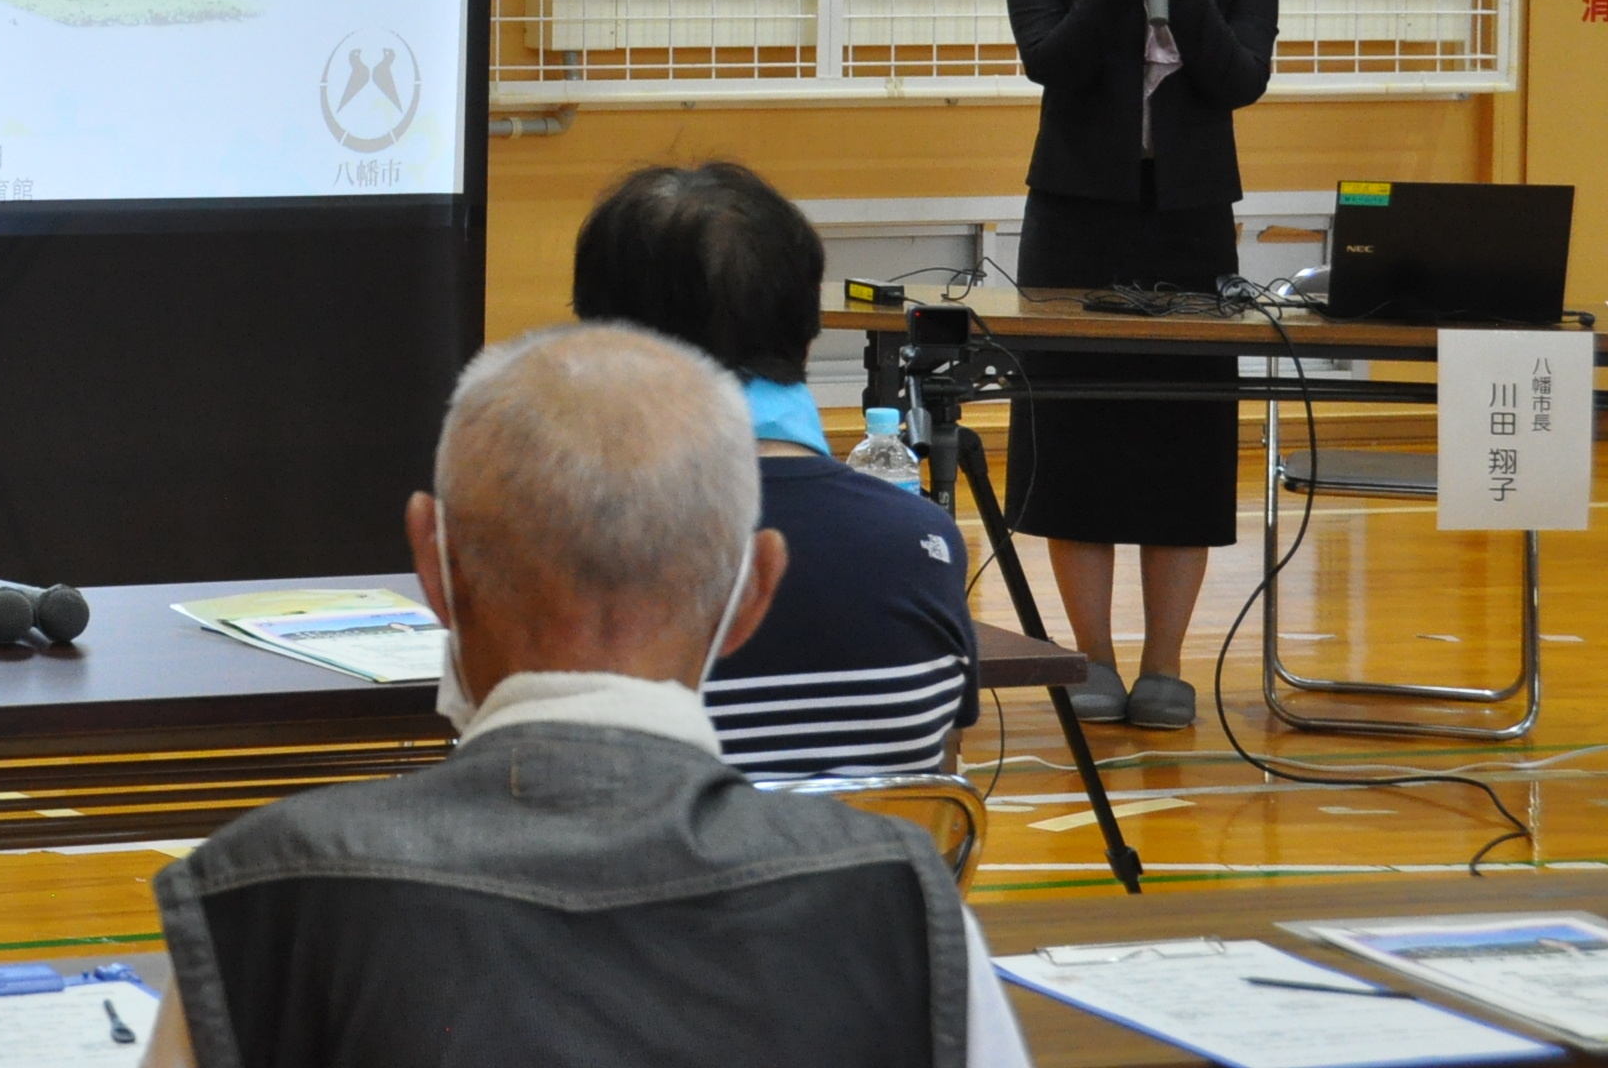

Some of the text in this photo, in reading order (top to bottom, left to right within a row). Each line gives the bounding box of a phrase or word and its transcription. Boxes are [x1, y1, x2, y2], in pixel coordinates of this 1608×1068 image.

[332, 158, 403, 188] 八幡市
[1345, 244, 1375, 254] NEC
[1531, 357, 1552, 432] 八幡市長
[1488, 382, 1517, 502] 川田 翔子
